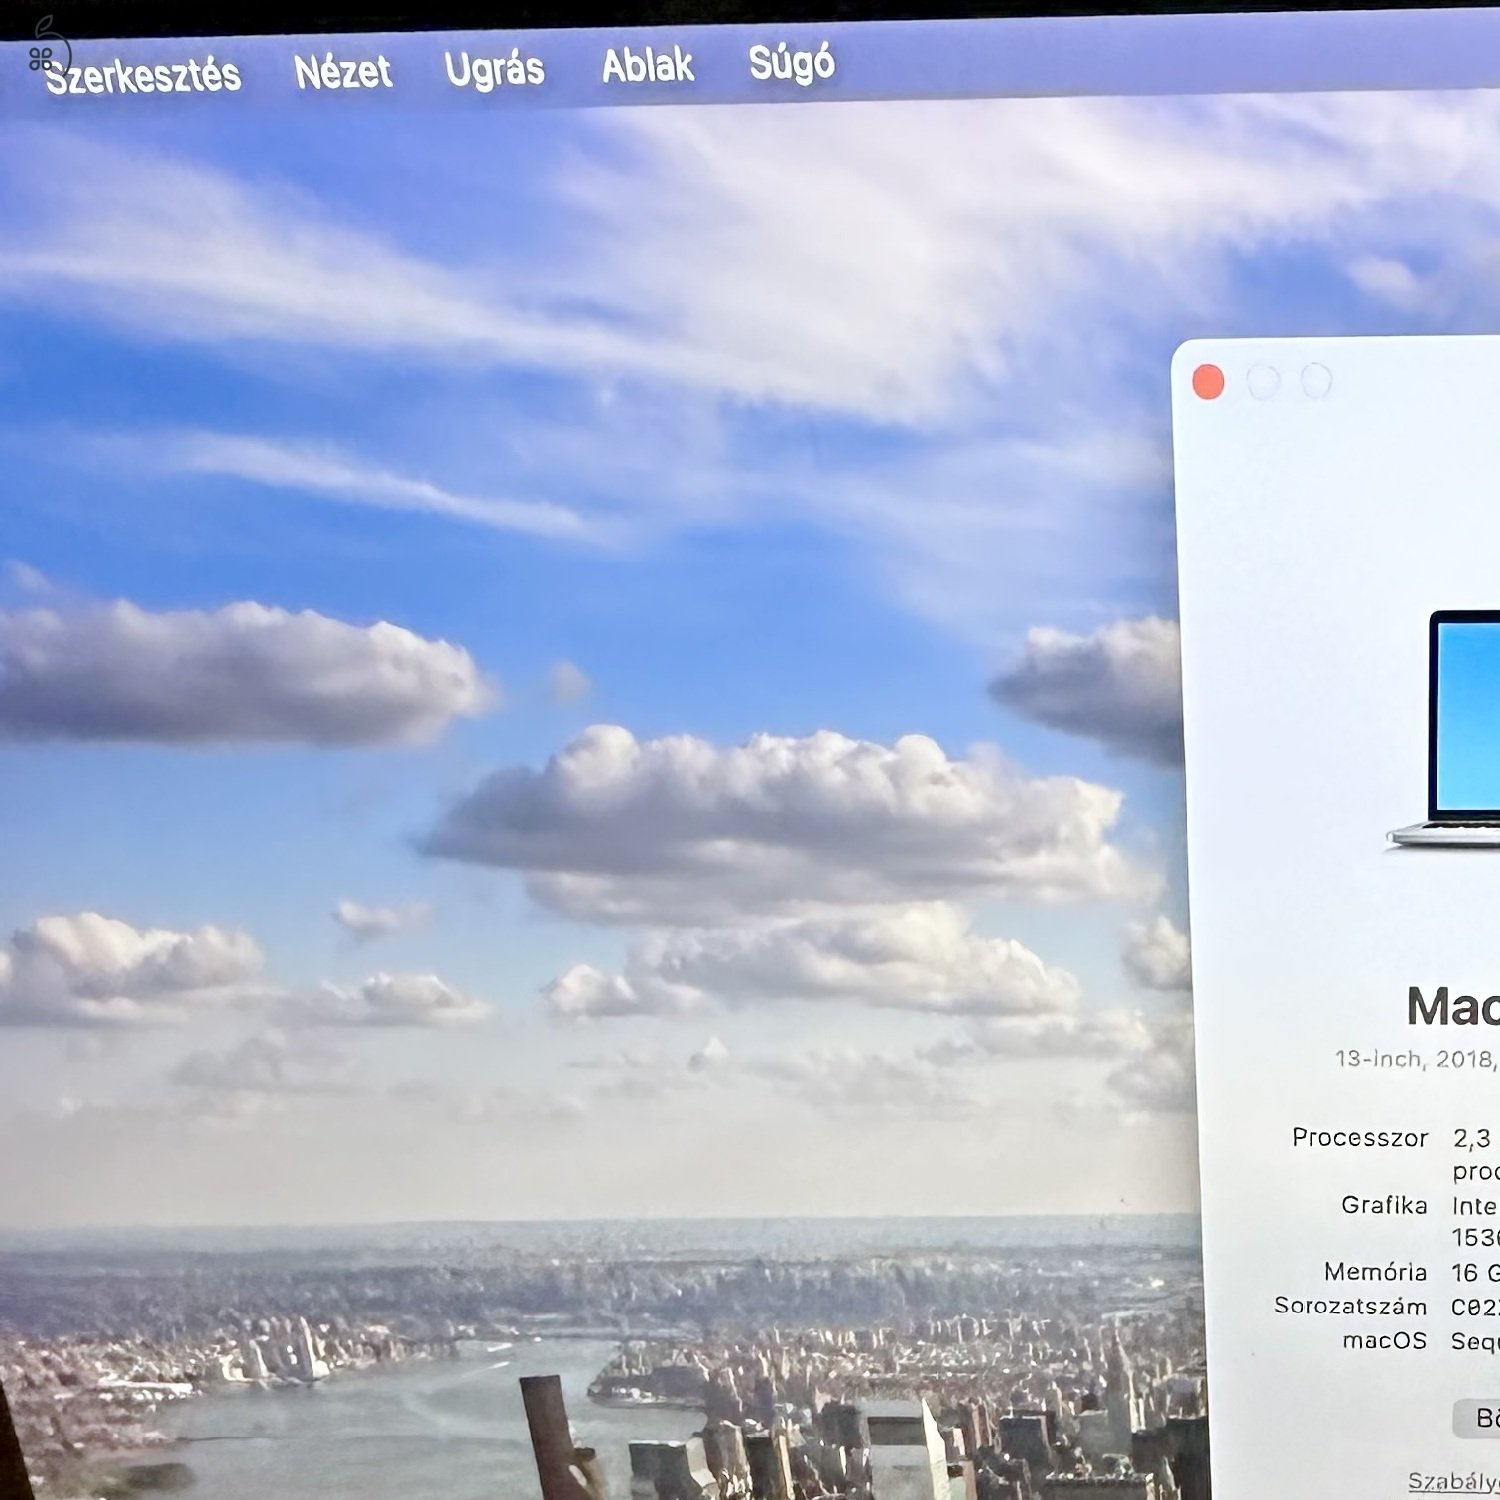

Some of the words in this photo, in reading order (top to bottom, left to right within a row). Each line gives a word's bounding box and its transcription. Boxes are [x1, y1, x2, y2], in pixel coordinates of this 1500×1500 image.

[44, 54, 242, 96] Szerkesztés
[294, 55, 393, 89] Nézet
[445, 50, 546, 93] Ugrás
[602, 45, 695, 84] Ablak
[748, 42, 836, 88] Súgó
[1336, 1049, 1425, 1071] 13-inch,
[1437, 1050, 1497, 1072] 2018,
[1294, 1127, 1429, 1147] Processzor
[1454, 1129, 1490, 1152] 2,3
[1342, 1195, 1427, 1214] Grafika
[1325, 1261, 1426, 1281] Memória
[1452, 1263, 1477, 1282] 16
[1275, 1296, 1427, 1315] Sorozatszám
[1343, 1331, 1427, 1349] macOS
